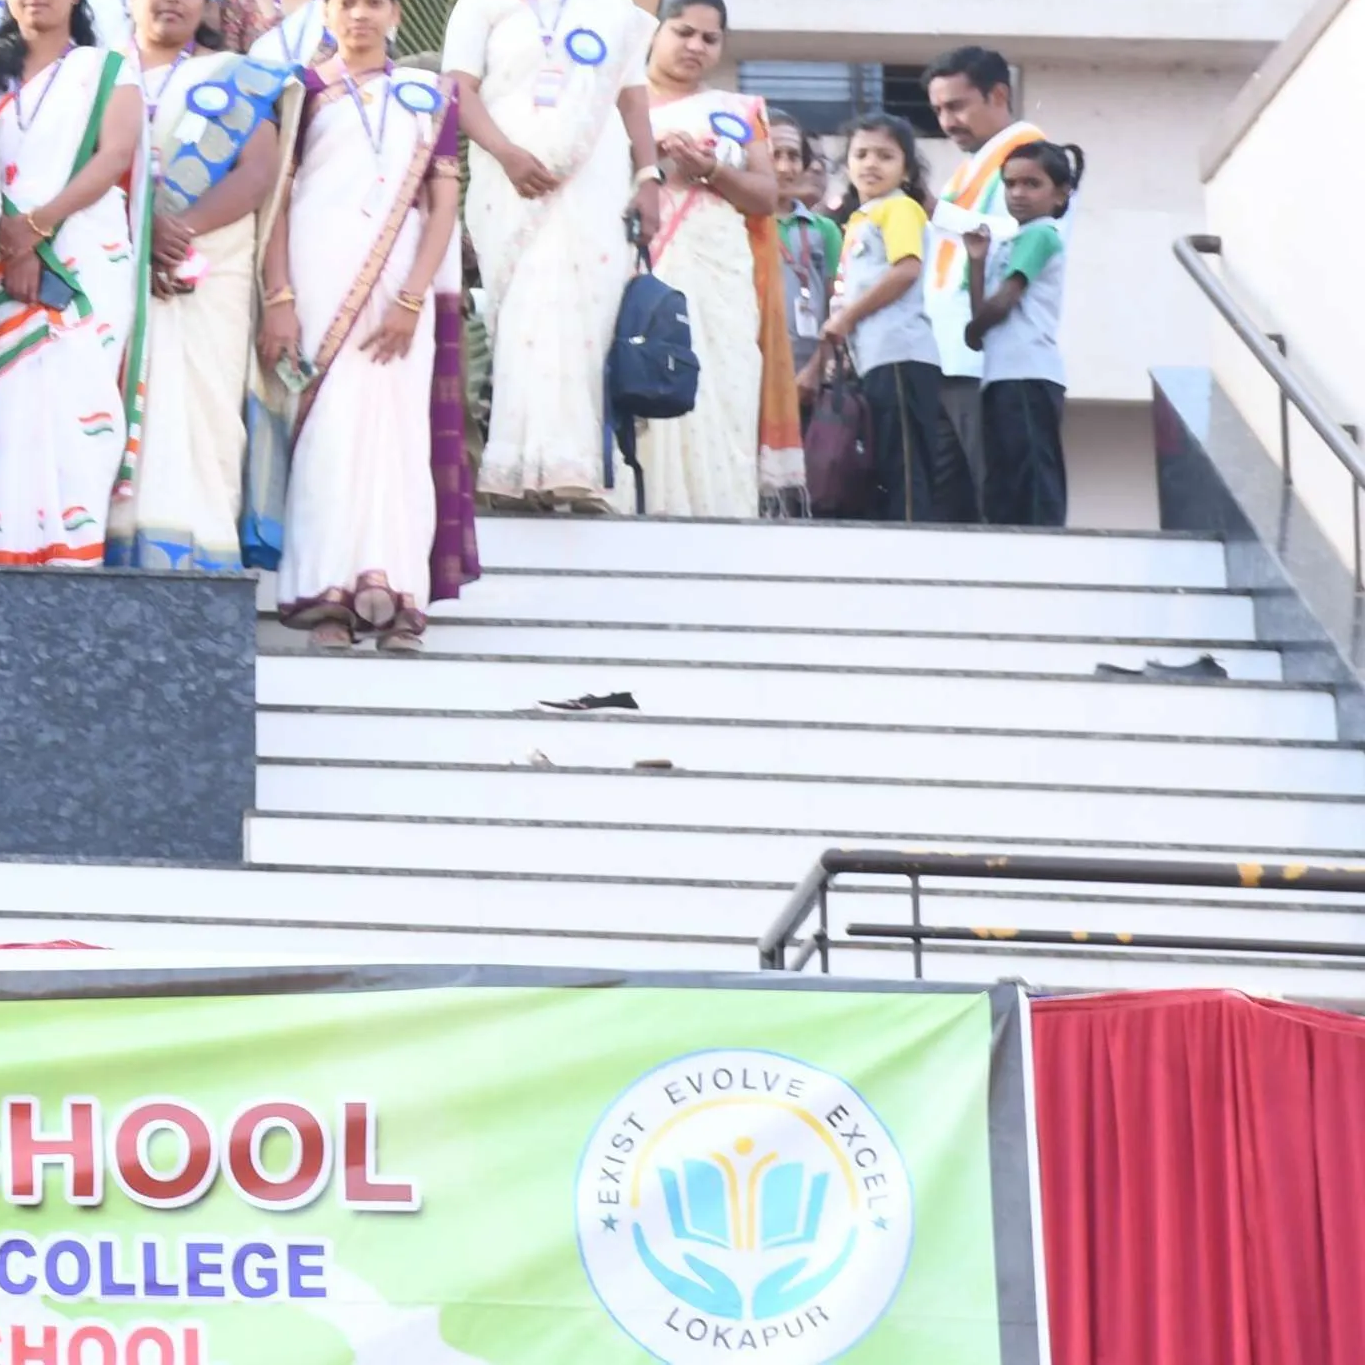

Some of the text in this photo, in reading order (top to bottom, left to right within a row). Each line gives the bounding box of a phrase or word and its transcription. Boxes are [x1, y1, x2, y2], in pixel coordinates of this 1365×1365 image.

[597, 1067, 889, 1211] EXIST EVOLVE EXCEL
[664, 1304, 831, 1351] LOKAPUR
